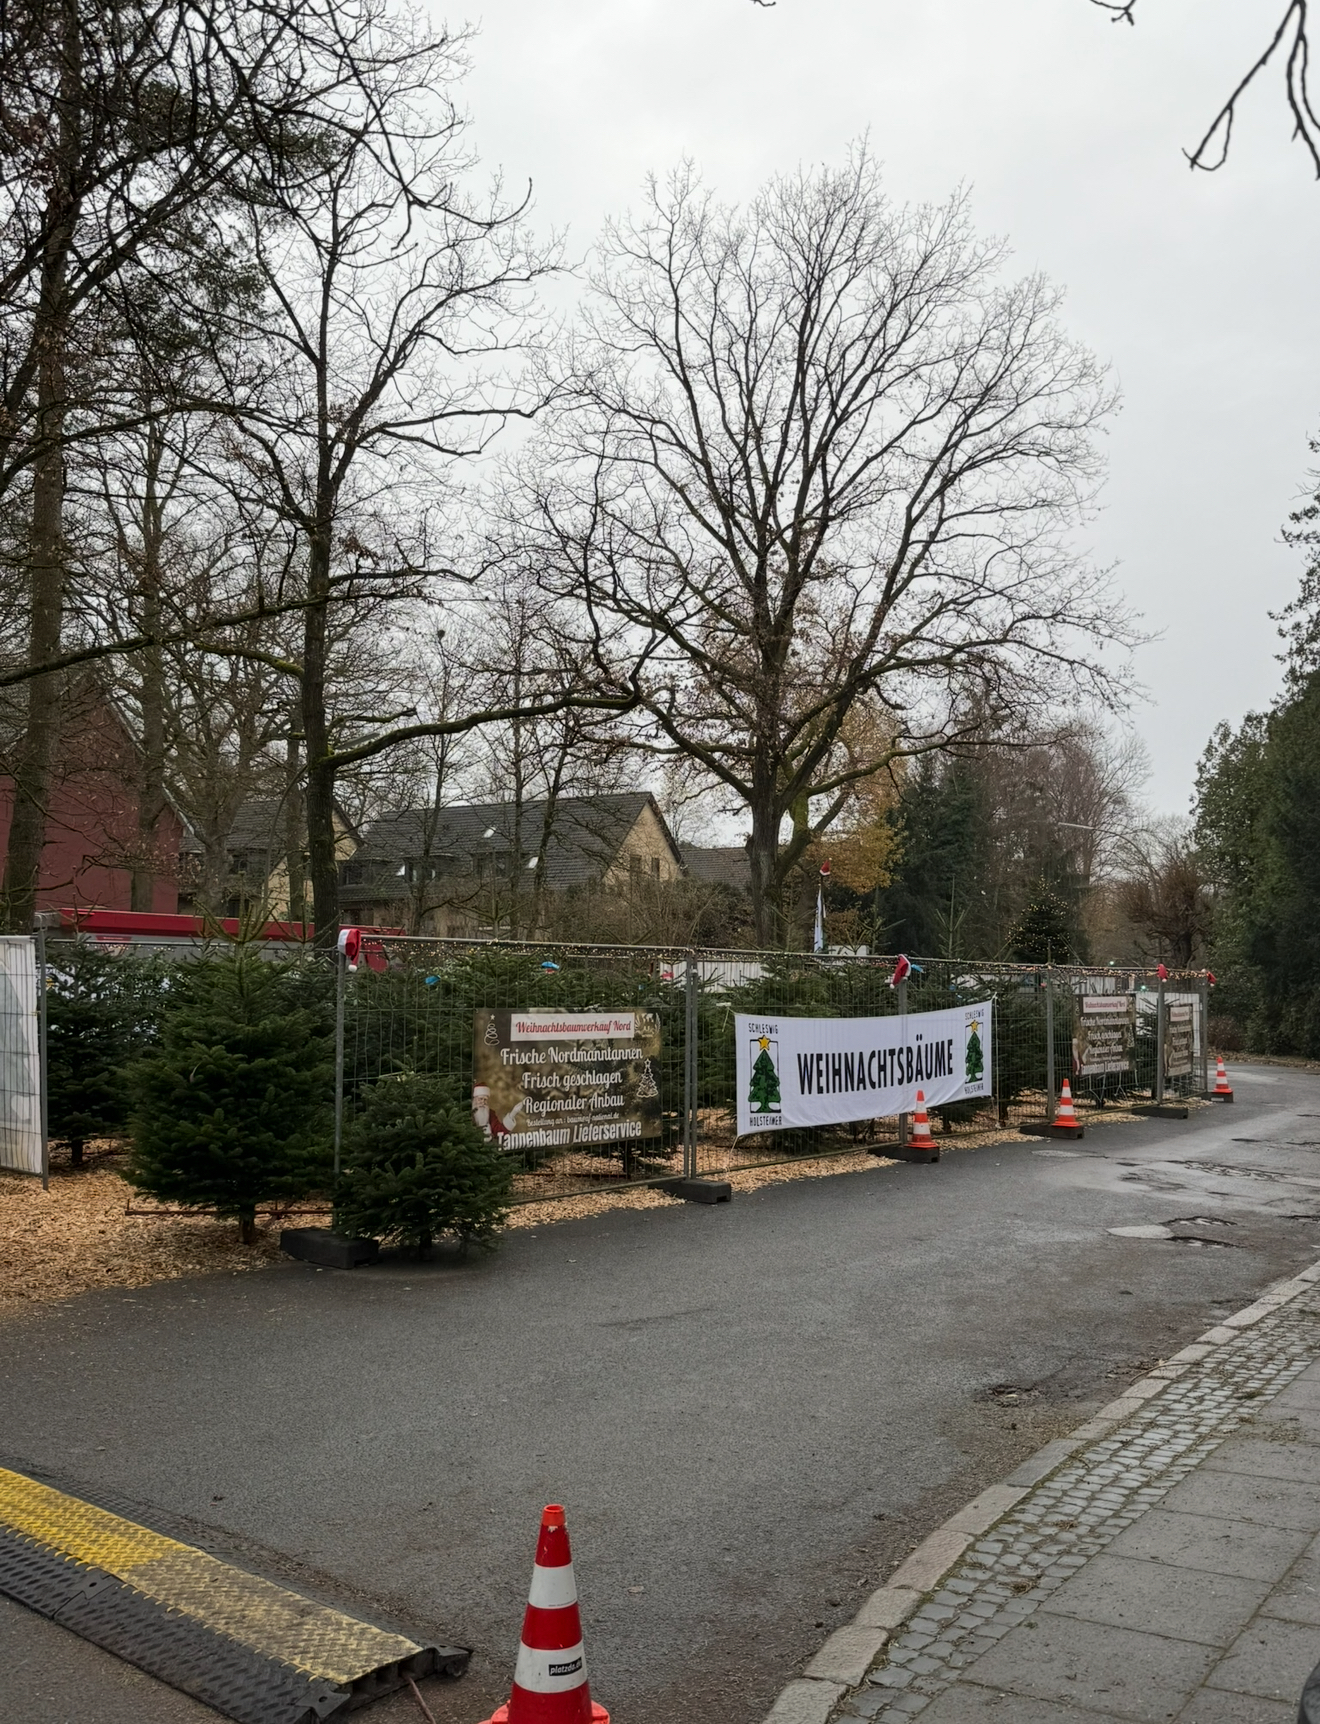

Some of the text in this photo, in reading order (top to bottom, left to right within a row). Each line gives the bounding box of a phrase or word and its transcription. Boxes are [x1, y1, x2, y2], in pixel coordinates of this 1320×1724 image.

[515, 1020, 632, 1035] Weihnachtsbaumverkauf Nord
[748, 1022, 779, 1034] SCHLESWIG
[500, 1046, 644, 1066] Frische Nordmanntannen
[797, 1034, 953, 1095] WEIHNACHTSBÄUME
[522, 1070, 623, 1091] Frisch geschlagen
[524, 1094, 625, 1118] Regionaler Anbau
[749, 1115, 783, 1127] HOLSTEINER
[497, 1119, 642, 1151] Tannenbaum Lieferservice
